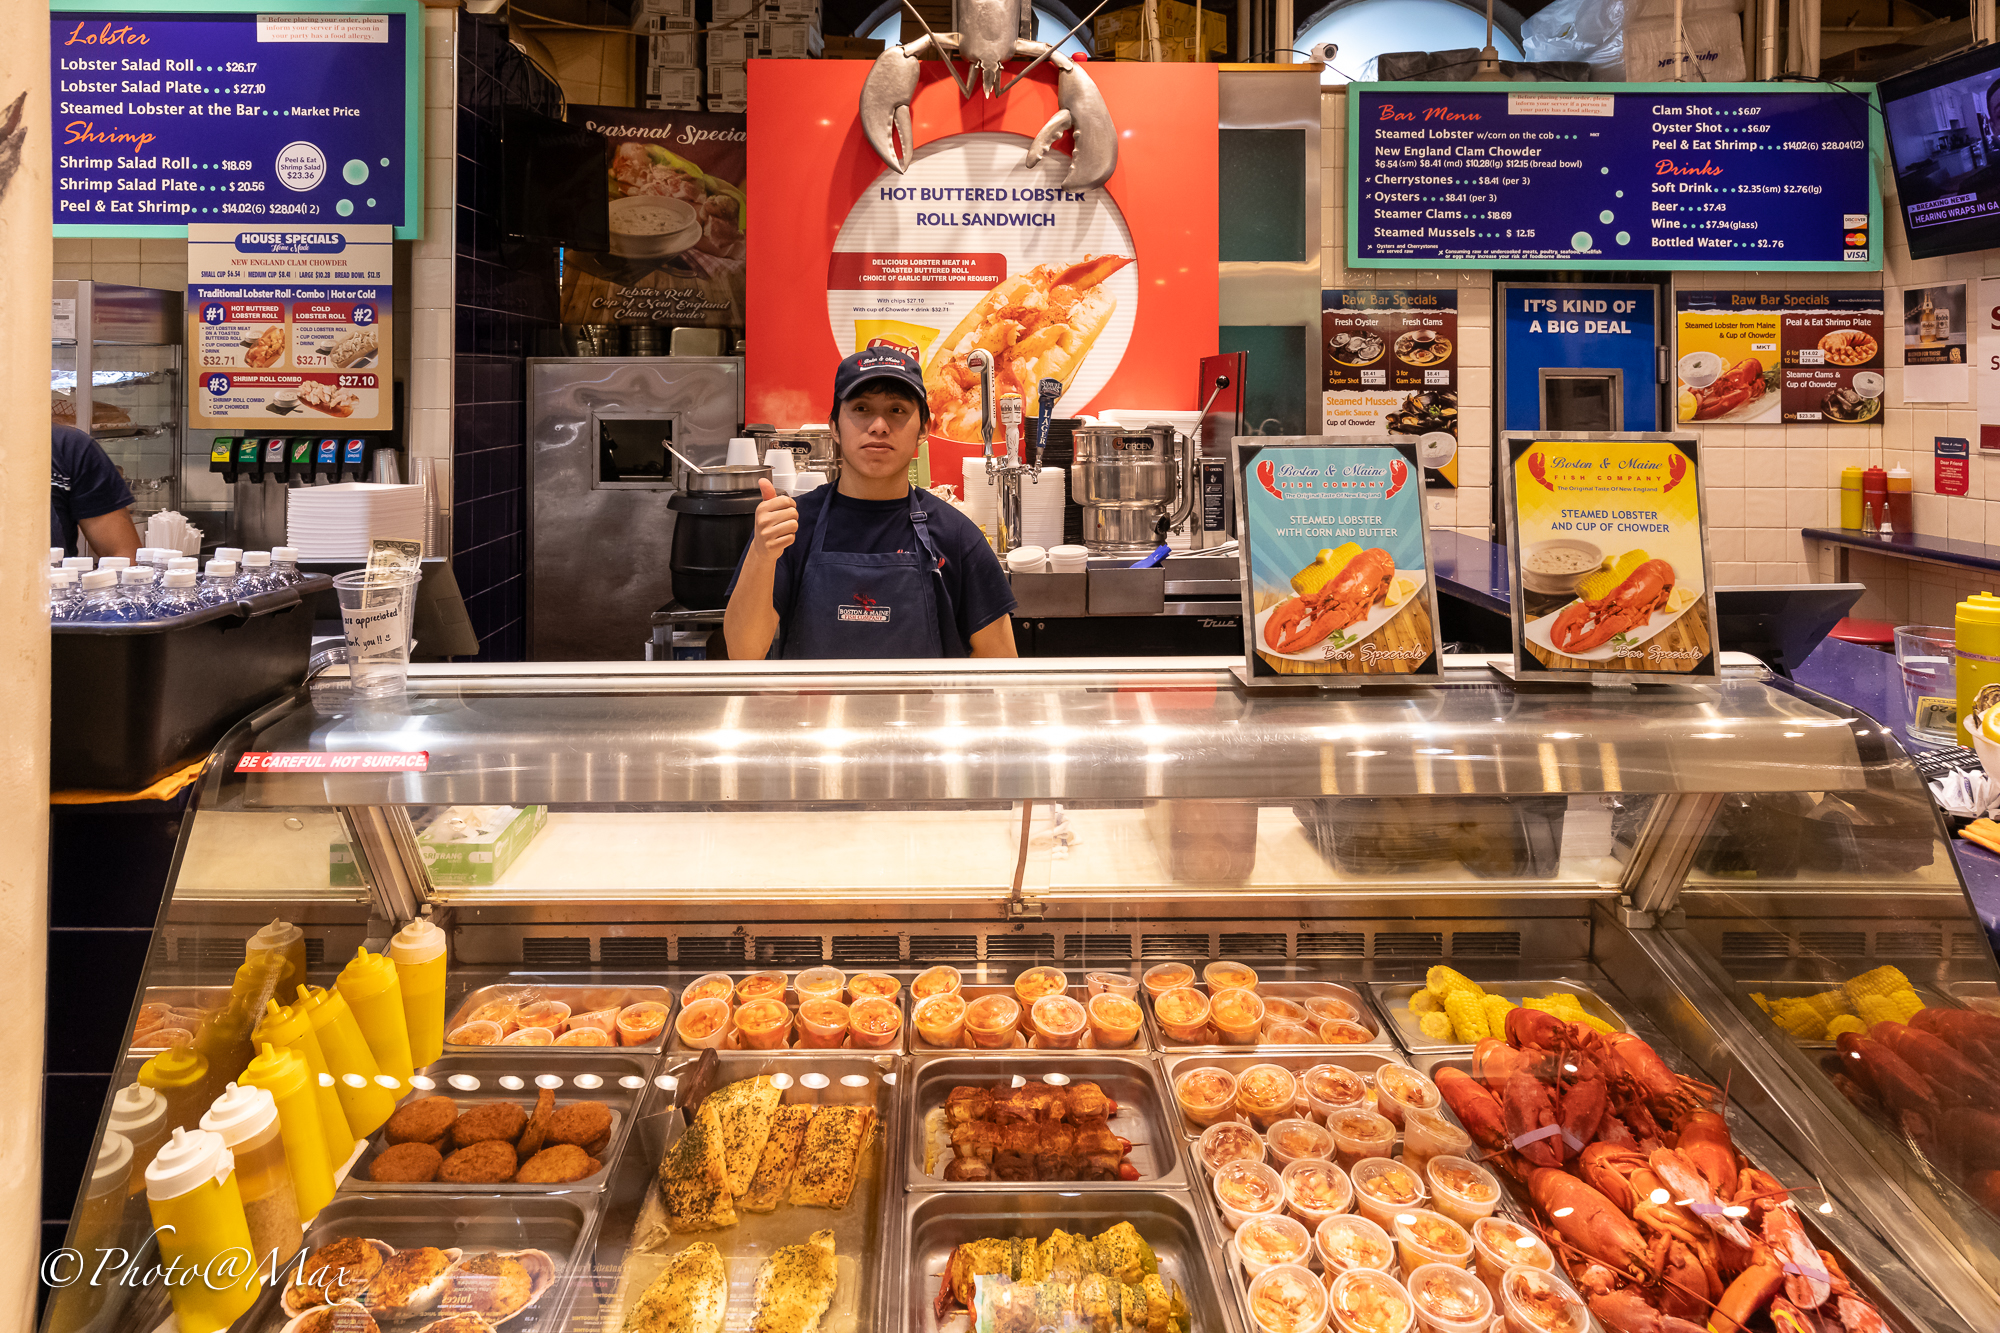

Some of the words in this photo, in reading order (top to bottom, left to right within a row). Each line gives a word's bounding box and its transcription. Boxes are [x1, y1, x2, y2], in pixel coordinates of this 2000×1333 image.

[63, 20, 151, 46] Lobster
[60, 57, 118, 71] Lobster
[121, 58, 161, 72] Salad
[165, 58, 194, 72] Roll
[225, 61, 258, 73] $26.17
[60, 101, 124, 115] Steamed
[128, 101, 185, 115] Lobster
[188, 104, 204, 116] at
[207, 102, 232, 116] the
[236, 103, 261, 116] Bar
[291, 106, 330, 117] Market
[333, 106, 360, 117] Price
[1378, 104, 1416, 122] Bar
[1422, 106, 1482, 122] Menu
[1652, 104, 1683, 116] Clam
[1685, 104, 1713, 116] Shot
[1738, 107, 1762, 116] $6.07
[63, 120, 157, 154] Shrimp
[1375, 128, 1425, 139] Steamed
[1429, 128, 1474, 139] Lobster
[1476, 131, 1507, 140] w/corn
[1509, 132, 1520, 140] on
[1522, 131, 1537, 140] the
[1538, 131, 1555, 140] cob
[1375, 146, 1401, 156] New
[1404, 145, 1452, 159] England
[1455, 145, 1485, 157] Clam
[1488, 146, 1542, 157] Chowder
[1654, 158, 1724, 176] Drinks
[287, 171, 315, 179] $23.36
[1374, 173, 1454, 187] Cherrystones
[1478, 176, 1499, 185] $8.41
[1502, 176, 1520, 186] (per
[1521, 176, 1531, 186] 3)
[880, 187, 917, 201] HOT
[920, 187, 1008, 202] BUTTERED
[1012, 187, 1086, 202] LOBSTER
[1651, 201, 1679, 212] Beer
[1703, 203, 1727, 212] $7.43
[1916, 199, 1949, 211] BREAKING
[1950, 194, 1970, 204] NEWS
[916, 212, 959, 227] ROLL
[961, 212, 1056, 227] SANDWICH
[1915, 210, 1948, 224] HEARING
[1948, 205, 1976, 218] WRAPS
[1976, 203, 1986, 213] IN
[241, 233, 282, 244] HOUSE
[285, 234, 339, 244] SPECIALS
[1651, 236, 1694, 248] Bottled
[1697, 237, 1733, 248] Water
[1757, 238, 1785, 249] $2.76
[1846, 251, 1867, 259] VISA
[872, 258, 909, 266] DELICIOUS
[881, 266, 913, 274] TOASTED
[197, 288, 243, 298] Traditional
[243, 288, 275, 299] Lobster
[274, 288, 292, 299] Roll
[295, 288, 326, 299] Combo
[330, 289, 346, 299] Hot
[346, 291, 357, 299] or
[356, 289, 376, 299] Cold
[616, 287, 660, 298] Lobster
[664, 288, 693, 300] Roll
[696, 290, 706, 300] &
[1342, 294, 1366, 305] Raw
[1370, 294, 1389, 305] Bar
[1393, 294, 1438, 306] Specials
[1524, 299, 1558, 313] IT'S
[1562, 299, 1608, 313] KIND
[1612, 300, 1637, 314] OF
[206, 307, 224, 321] #1
[354, 308, 373, 322] #2
[614, 308, 649, 319] Clam
[652, 309, 706, 320] Chowder
[1334, 318, 1353, 326] Fresh
[1355, 318, 1379, 327] Oyster
[1528, 319, 1543, 333] A
[1547, 320, 1579, 334] BIG
[1584, 320, 1632, 334] DEAL
[1803, 318, 1811, 327] &
[1811, 318, 1824, 326] Eat
[1824, 318, 1851, 327] Shrimp
[1852, 318, 1872, 326] Plate
[203, 355, 235, 367] $32.71
[296, 355, 328, 366] $32.71
[209, 377, 228, 392] #3
[259, 375, 277, 383] ROLL
[277, 375, 303, 383] COMBO
[338, 375, 375, 387] $27.10
[1039, 409, 1050, 445] LAGER
[1125, 442, 1152, 450] GROEN
[1550, 457, 1593, 469] Boston
[1599, 457, 1611, 469] &
[1618, 457, 1663, 470] Maine
[1290, 515, 1336, 525] STEAMED
[1338, 515, 1383, 525] LOBSTER
[1276, 528, 1302, 537] WITH
[1305, 528, 1333, 537] CORN
[1335, 528, 1356, 537] AND
[1359, 528, 1398, 537] BUTTER
[1551, 521, 1573, 531] AND
[1575, 522, 1597, 531] CUP
[1599, 522, 1614, 532] OF
[1617, 522, 1670, 533] CHOWDER
[1321, 644, 1355, 660] Bar
[1360, 643, 1426, 667] Specials
[238, 755, 260, 768] BE
[261, 755, 327, 768] CAREFUL.
[329, 755, 360, 767] HOT
[361, 755, 427, 767] SURFACE.
